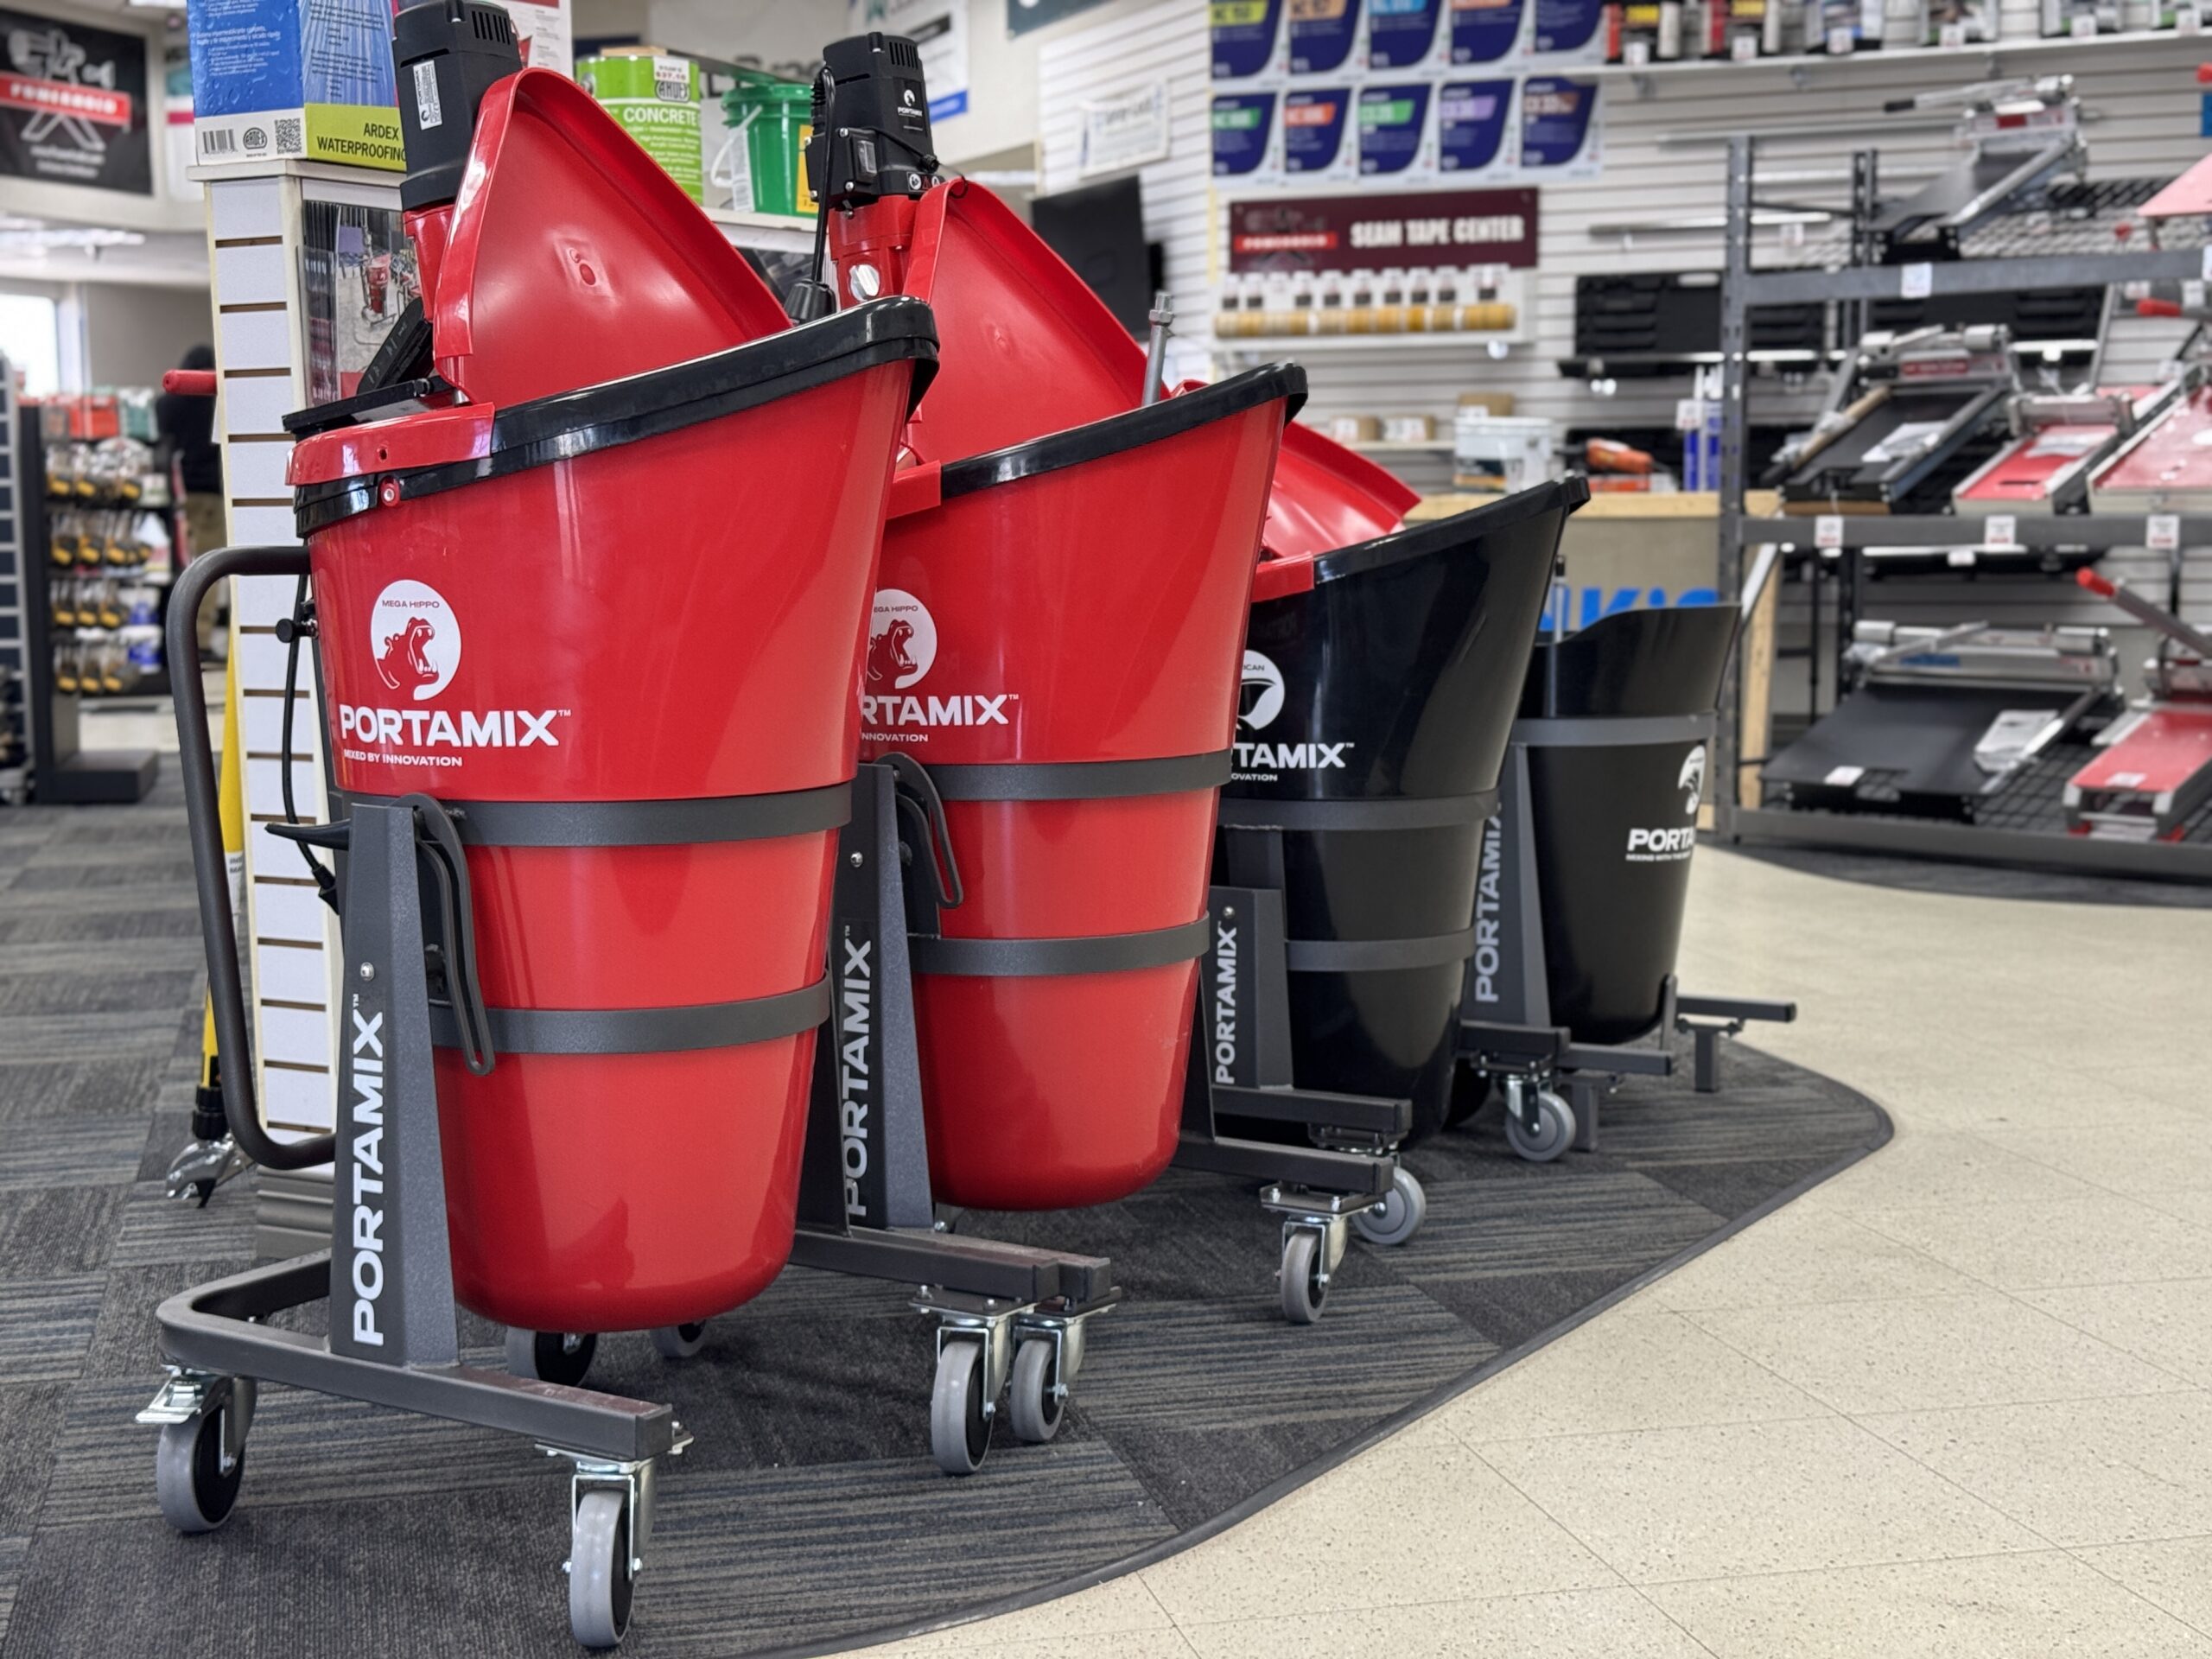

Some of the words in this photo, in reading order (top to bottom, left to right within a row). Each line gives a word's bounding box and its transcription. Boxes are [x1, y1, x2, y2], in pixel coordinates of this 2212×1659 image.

[623, 106, 696, 127] CONCRETE
[363, 122, 400, 141] ARDEX
[1350, 220, 1403, 249] SEAM
[1405, 218, 1451, 246] TAPE
[1453, 215, 1524, 245] CENTER
[382, 600, 408, 608] MEGA
[410, 601, 441, 609] HIPPO
[862, 694, 1020, 727] RTAMIX™
[861, 732, 929, 743] NNOVATION
[344, 748, 366, 762] MIXED
[367, 752, 381, 763] BY
[382, 753, 463, 767] INNOVATION
[1233, 741, 1355, 769] TAMIX™
[1231, 772, 1279, 782] OVATION
[1627, 826, 1694, 852] PORTA
